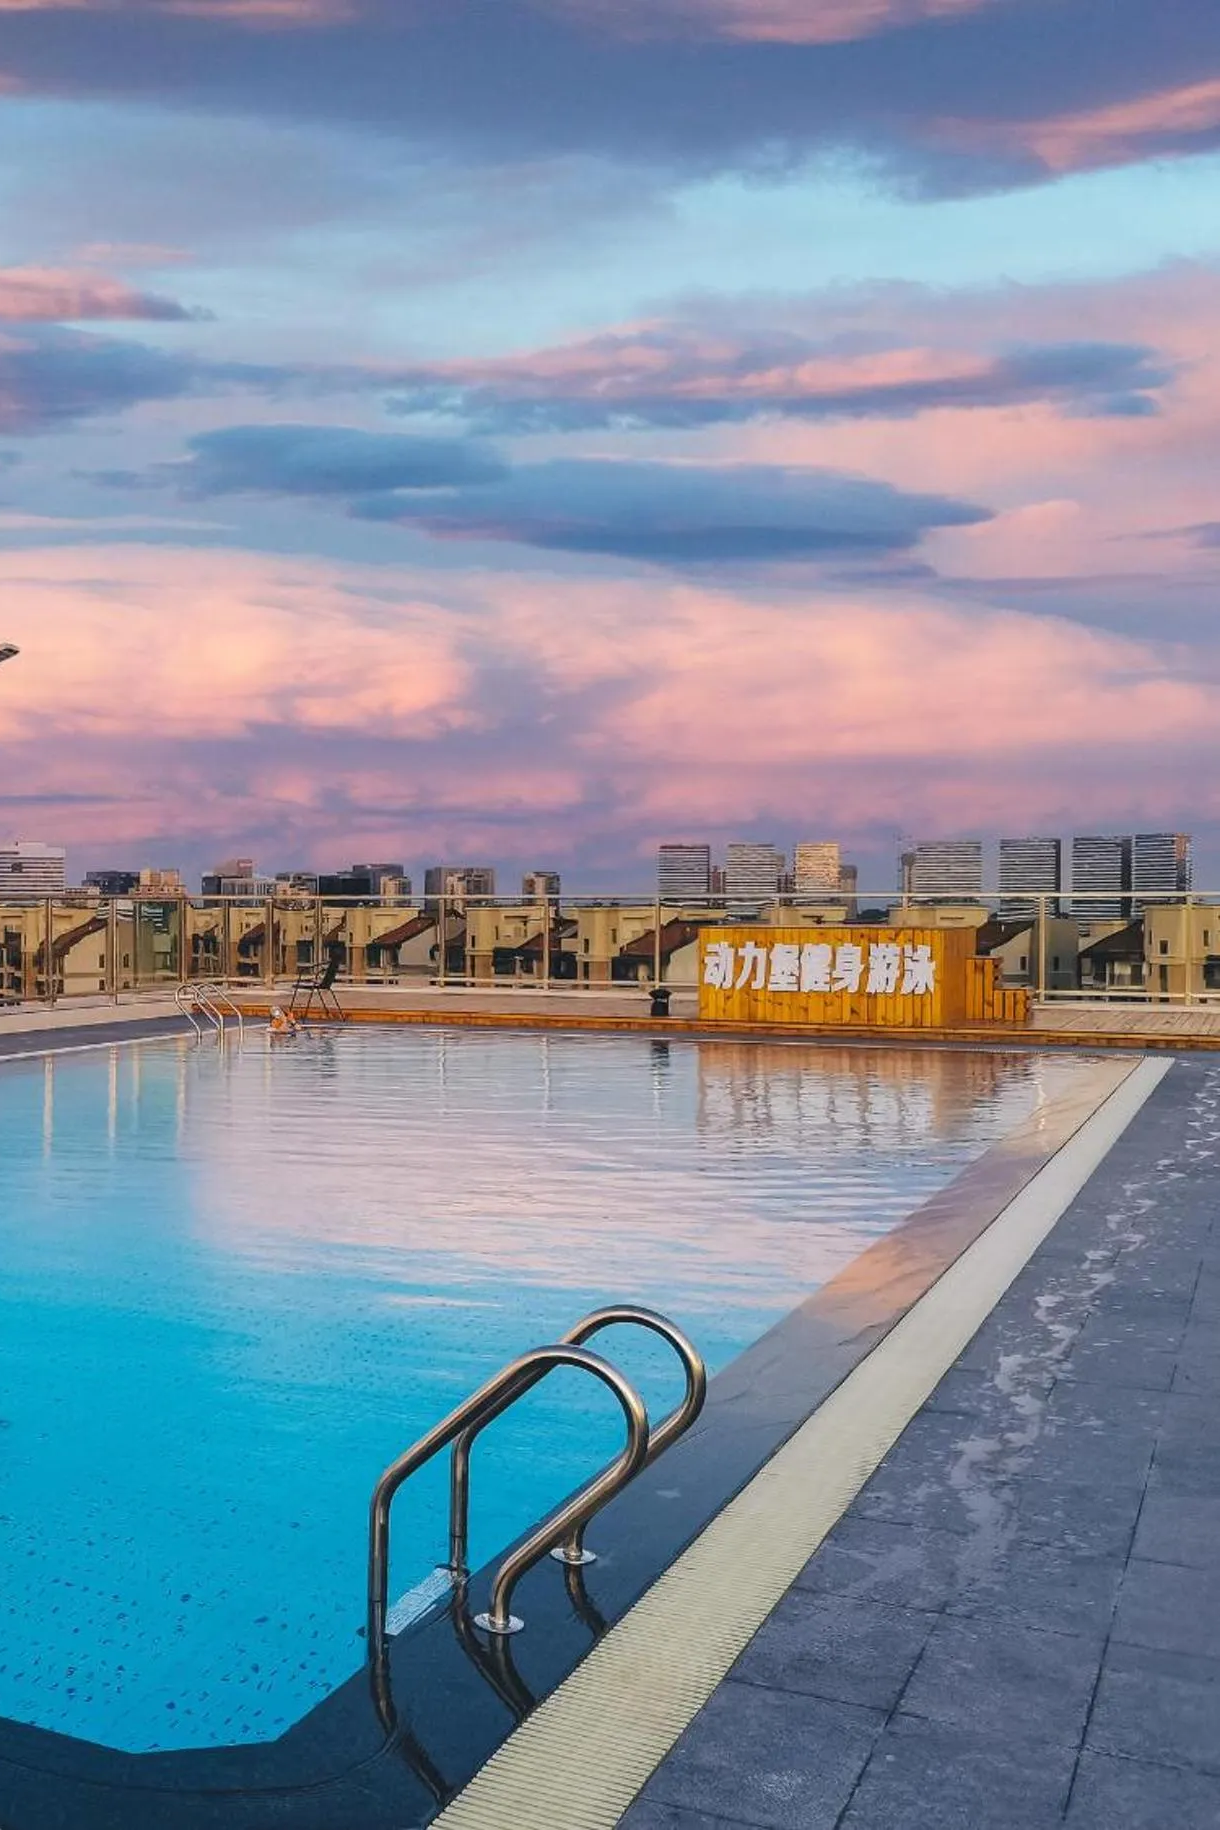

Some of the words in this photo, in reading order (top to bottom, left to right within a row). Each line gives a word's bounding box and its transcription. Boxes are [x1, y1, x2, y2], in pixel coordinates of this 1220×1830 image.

[703, 941, 937, 994] 动力堡健身游泳
